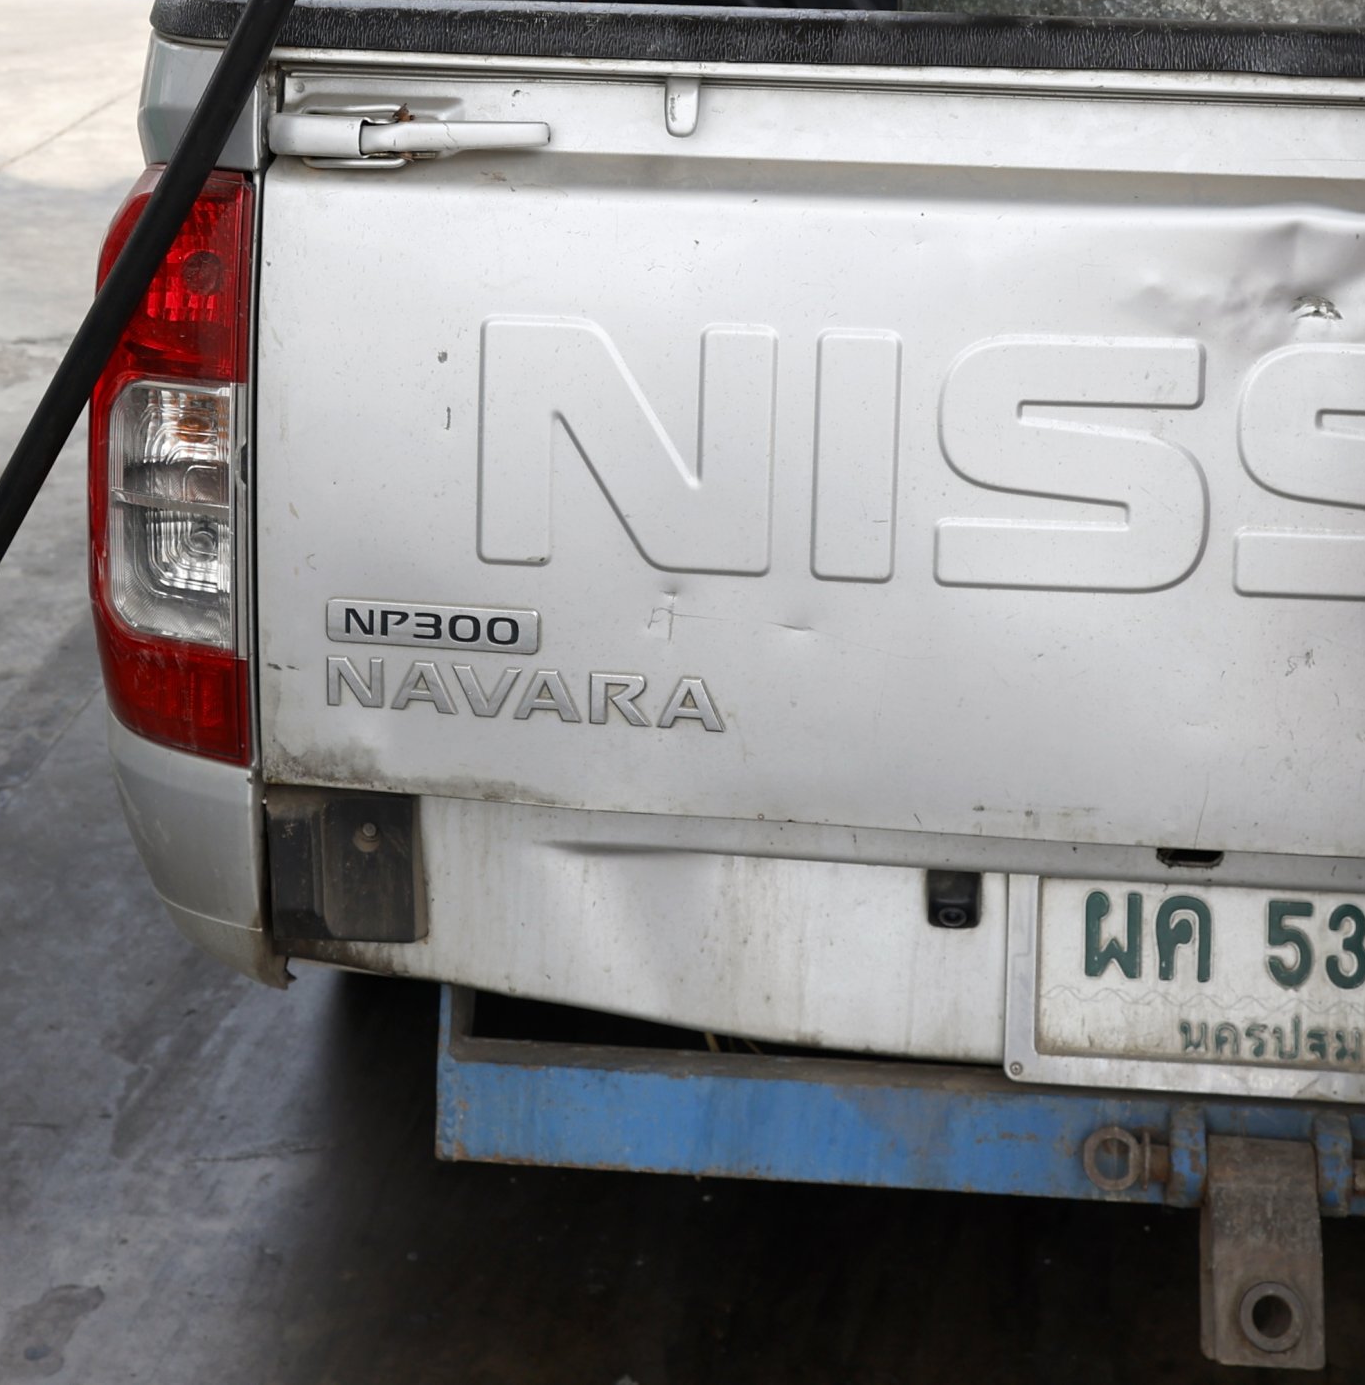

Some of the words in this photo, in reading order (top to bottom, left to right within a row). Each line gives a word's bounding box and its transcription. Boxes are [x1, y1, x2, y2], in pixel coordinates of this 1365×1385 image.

[344, 606, 520, 647] NP300
[326, 655, 726, 733] NAVARA
[1083, 889, 1214, 984] ผค
